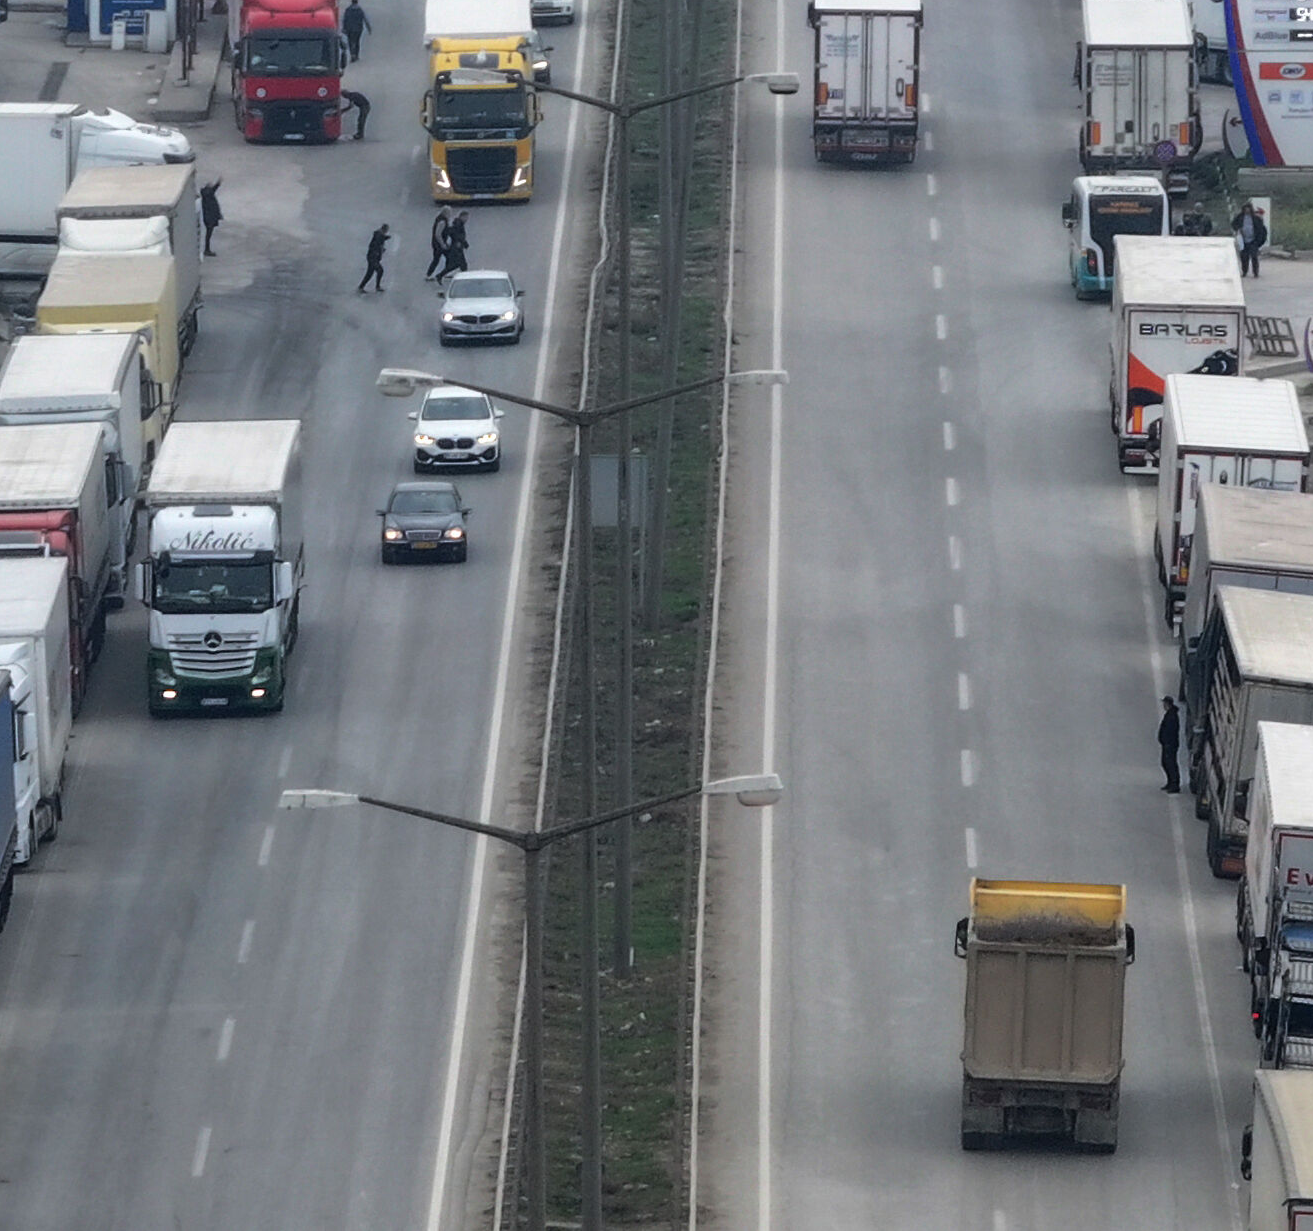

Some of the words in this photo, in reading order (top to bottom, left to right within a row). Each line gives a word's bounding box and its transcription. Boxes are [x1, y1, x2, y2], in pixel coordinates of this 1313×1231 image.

[1254, 31, 1288, 41] AdBlue
[1139, 323, 1228, 337] BARLAS
[170, 529, 254, 551] Nikolić
